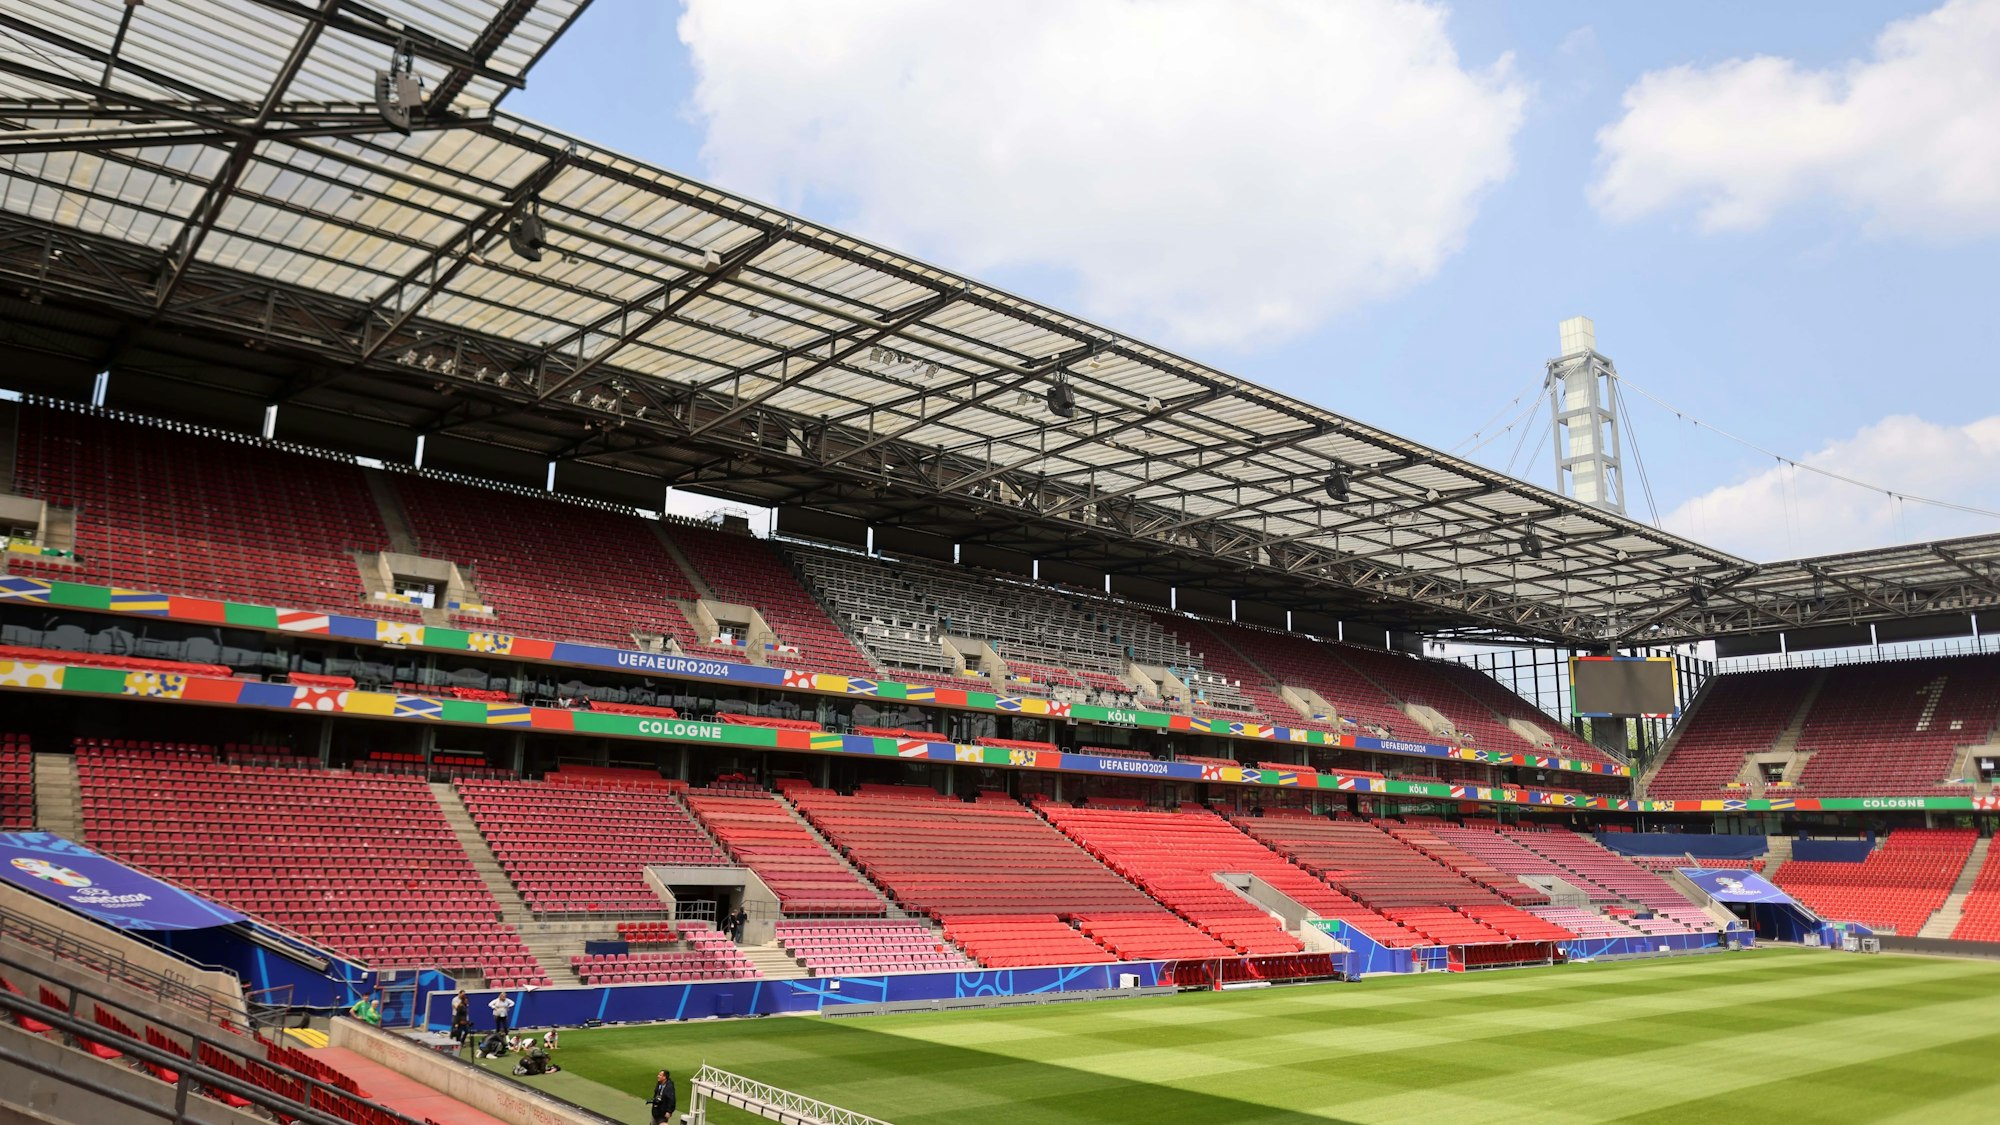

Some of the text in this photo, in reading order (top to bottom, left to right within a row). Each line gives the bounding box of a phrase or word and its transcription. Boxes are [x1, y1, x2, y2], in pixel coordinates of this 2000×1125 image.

[1108, 710, 1135, 722] KÖLN
[639, 721, 721, 738] COLOGNE
[1409, 784, 1428, 794] KÖLN
